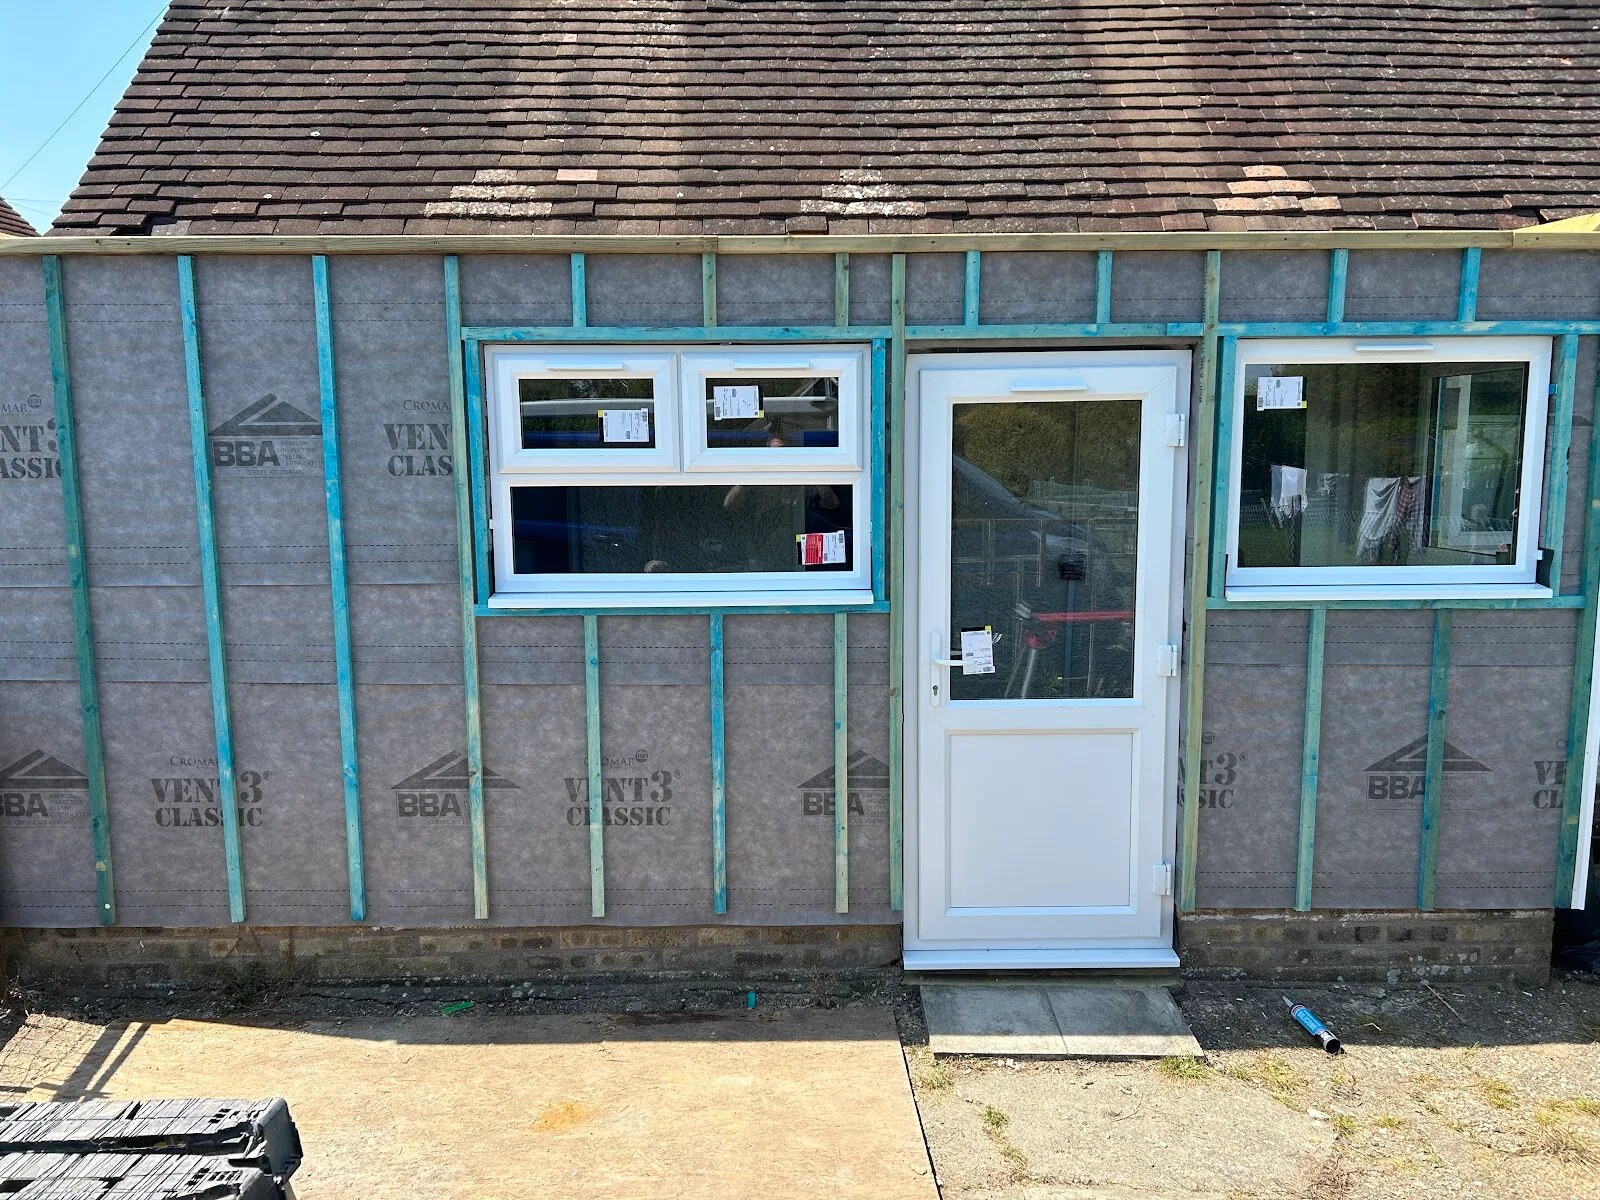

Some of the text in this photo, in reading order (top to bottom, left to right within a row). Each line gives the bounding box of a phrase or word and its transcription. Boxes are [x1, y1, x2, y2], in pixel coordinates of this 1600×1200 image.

[403, 400, 451, 411] CROMA
[383, 423, 452, 450] VEN
[213, 441, 280, 467] BBA
[388, 454, 453, 476] CLAS
[0, 457, 61, 479] ASSI
[170, 757, 219, 767] CROMA
[0, 793, 49, 817] BA
[398, 793, 462, 817] BBA
